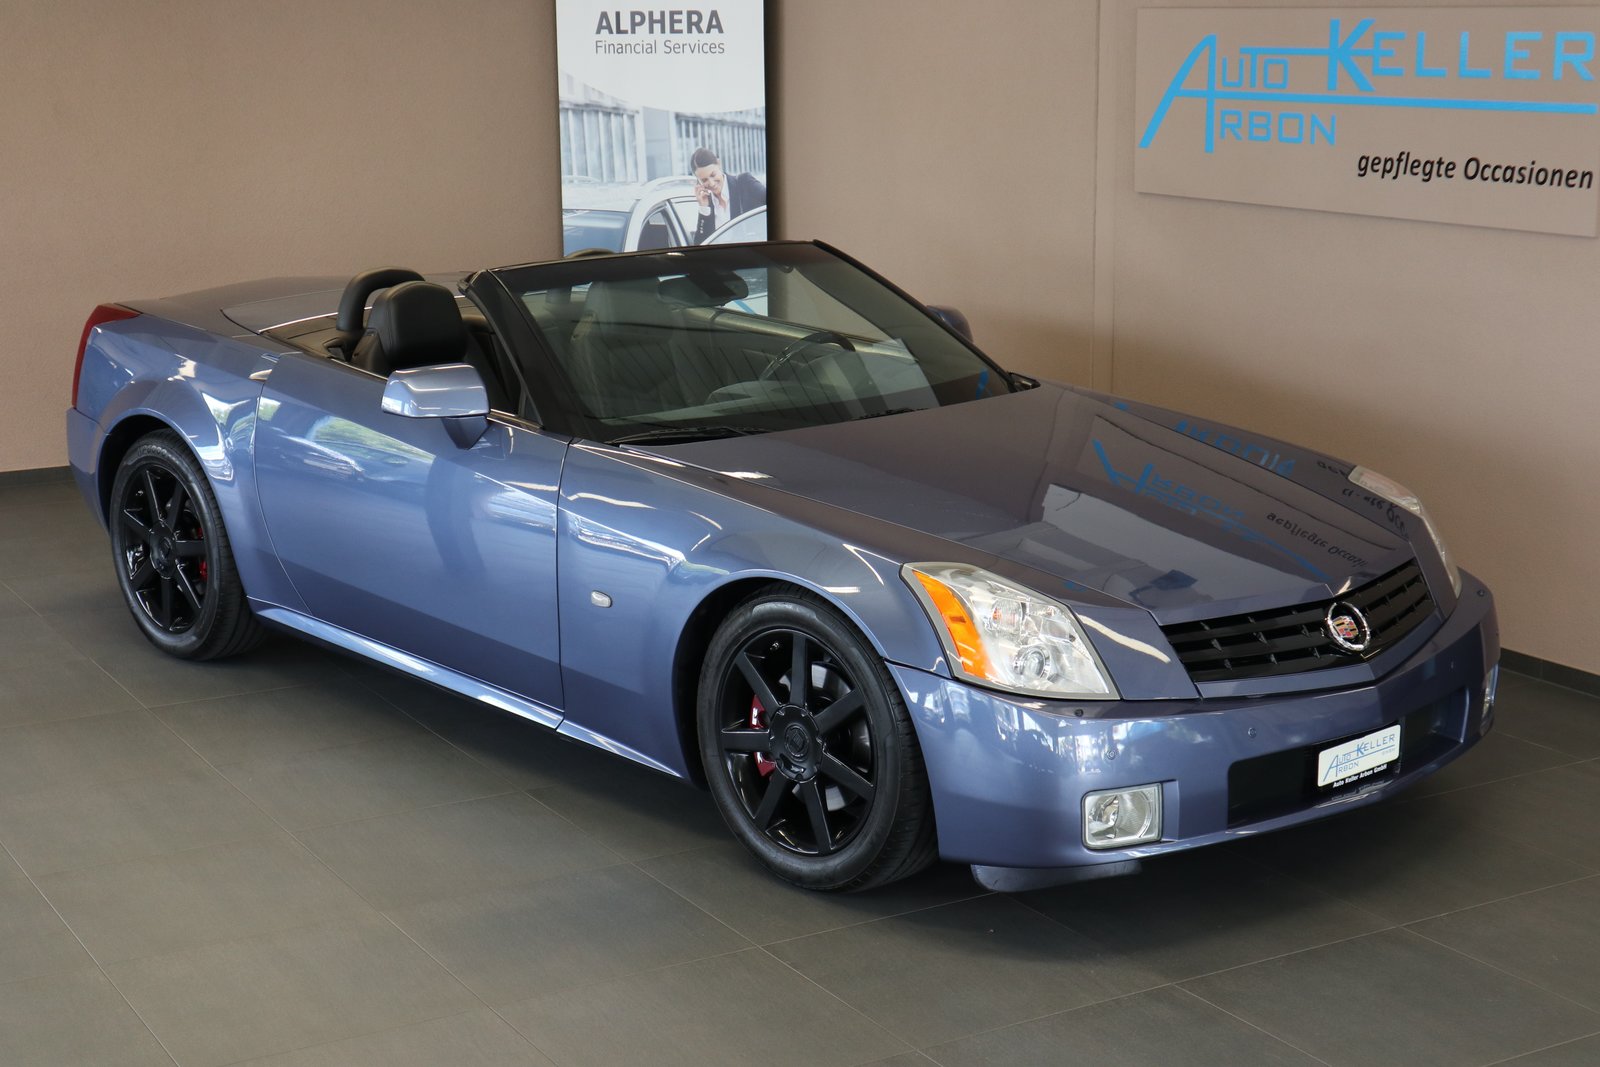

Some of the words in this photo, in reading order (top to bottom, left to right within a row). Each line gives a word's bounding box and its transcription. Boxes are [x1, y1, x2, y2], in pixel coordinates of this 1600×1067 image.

[595, 10, 724, 34] ALPHERA
[595, 40, 657, 54] Financial
[663, 40, 725, 54] Services
[1326, 18, 1596, 92] KELLER
[1357, 151, 1456, 182] gepflegte
[1464, 157, 1594, 189] Occasionen
[1356, 734, 1395, 756] KELLER
[1332, 780, 1345, 788] Auto
[1345, 774, 1359, 784] Keller
[1359, 769, 1373, 779] Arbon
